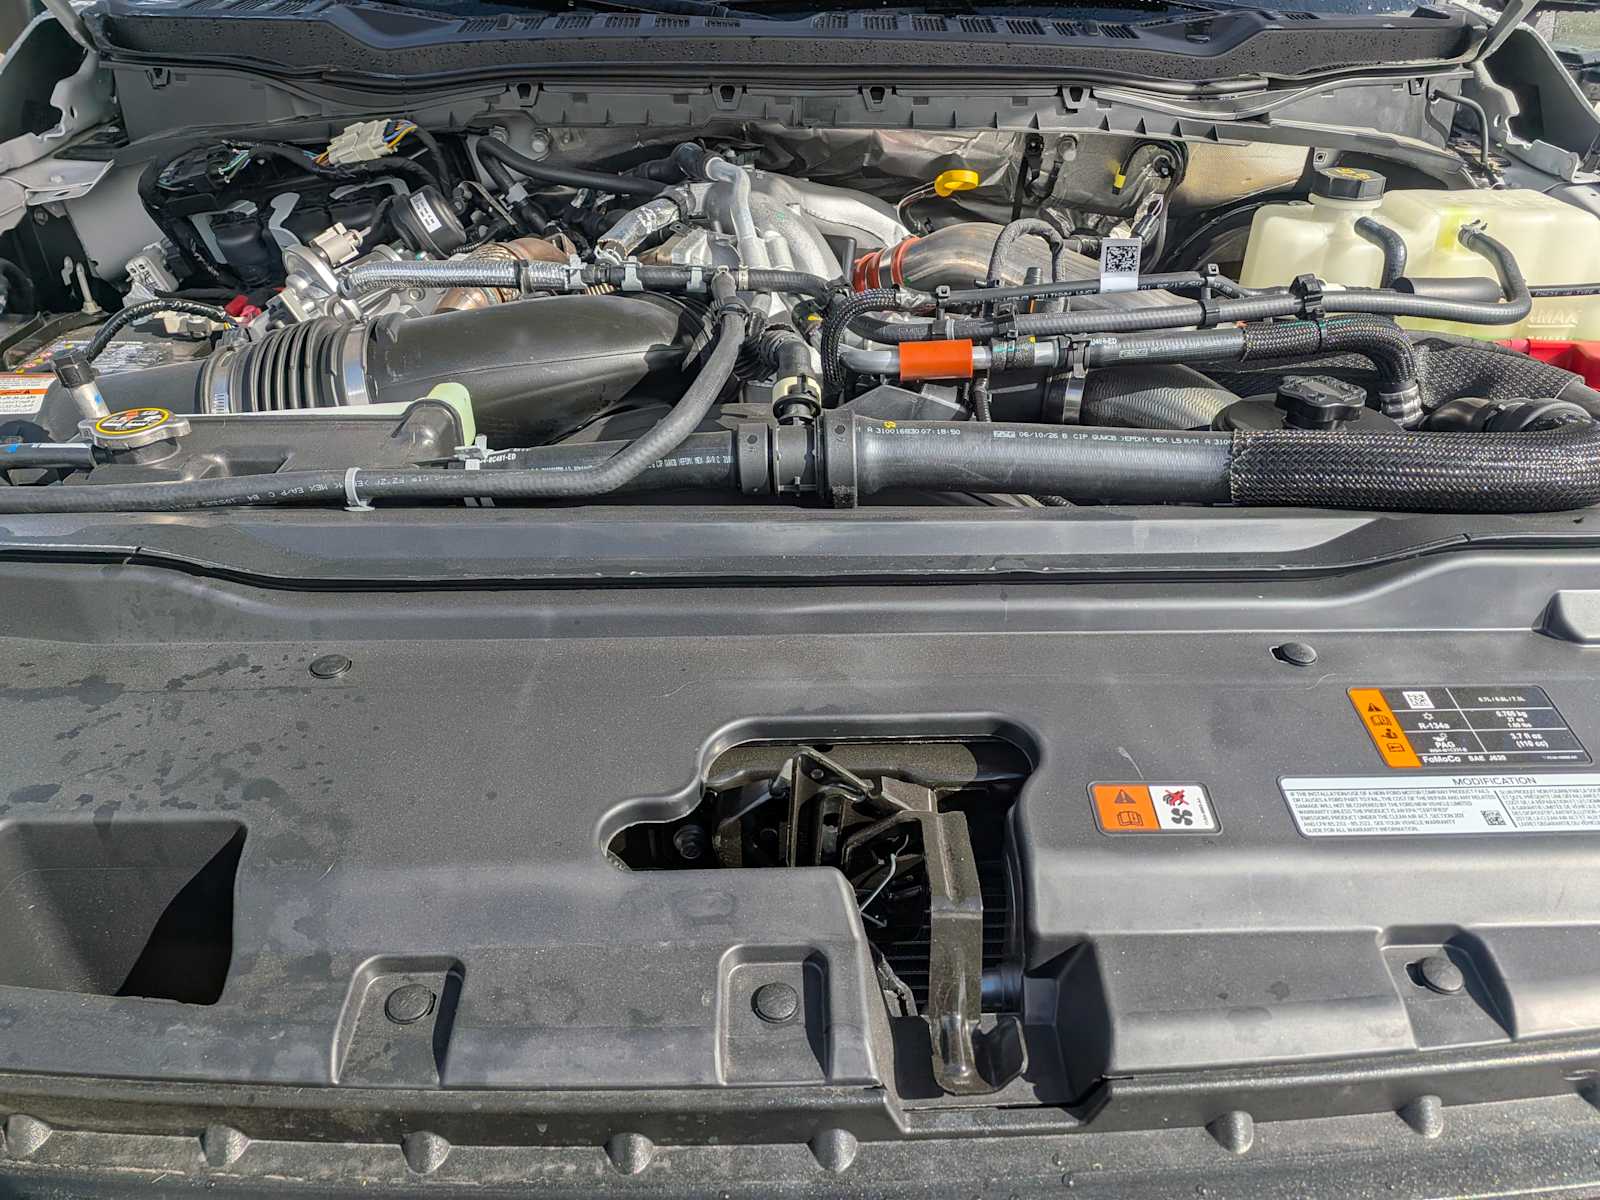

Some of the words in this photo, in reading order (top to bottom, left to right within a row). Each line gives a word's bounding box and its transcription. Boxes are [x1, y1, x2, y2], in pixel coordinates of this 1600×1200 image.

[1435, 741, 1456, 749] PAG
[1423, 755, 1461, 763] FoMoCo
[1452, 776, 1536, 786] MODIFICATION
